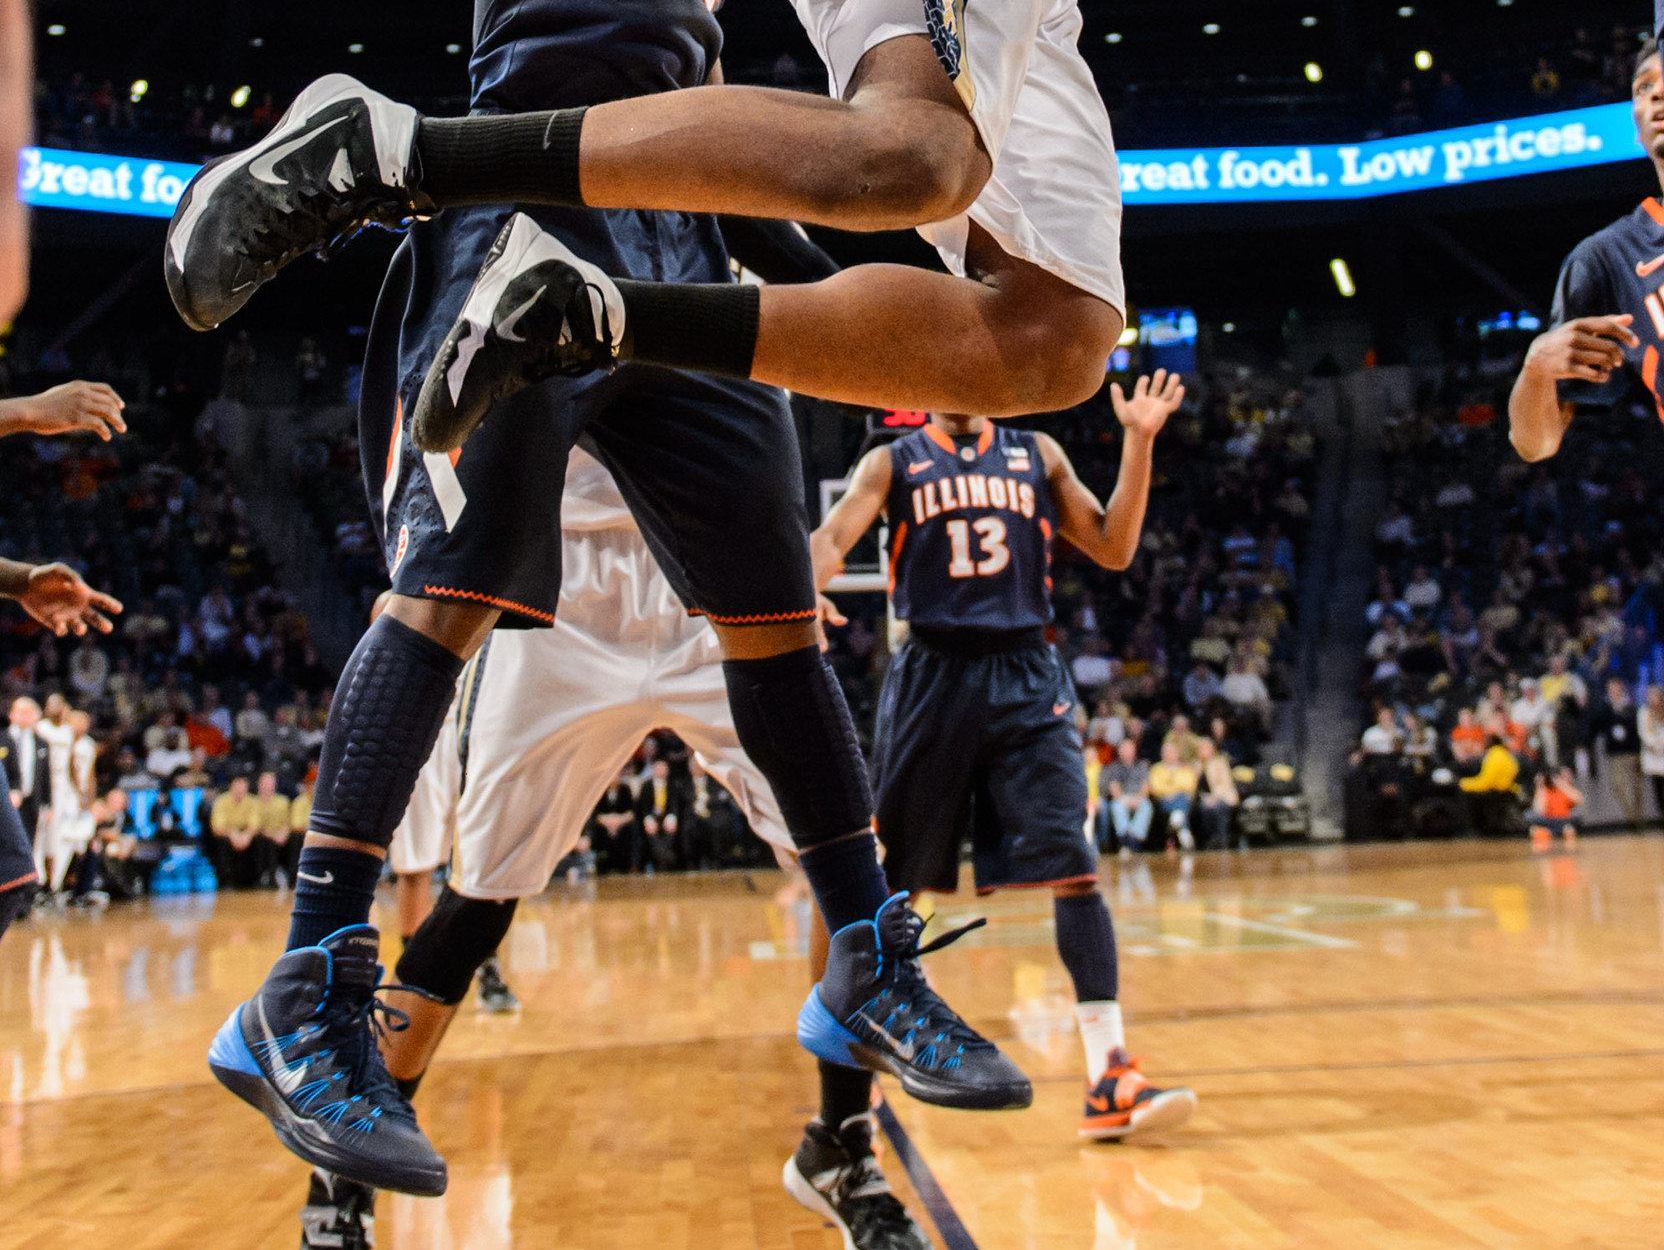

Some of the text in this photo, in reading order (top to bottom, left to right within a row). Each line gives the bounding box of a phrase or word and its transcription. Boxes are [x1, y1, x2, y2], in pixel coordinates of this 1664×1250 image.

[139, 162, 195, 205] fo
[1117, 122, 1603, 192] reat food. Low prices.
[912, 474, 1035, 525] ILLINOIS
[946, 516, 1011, 579] 13
